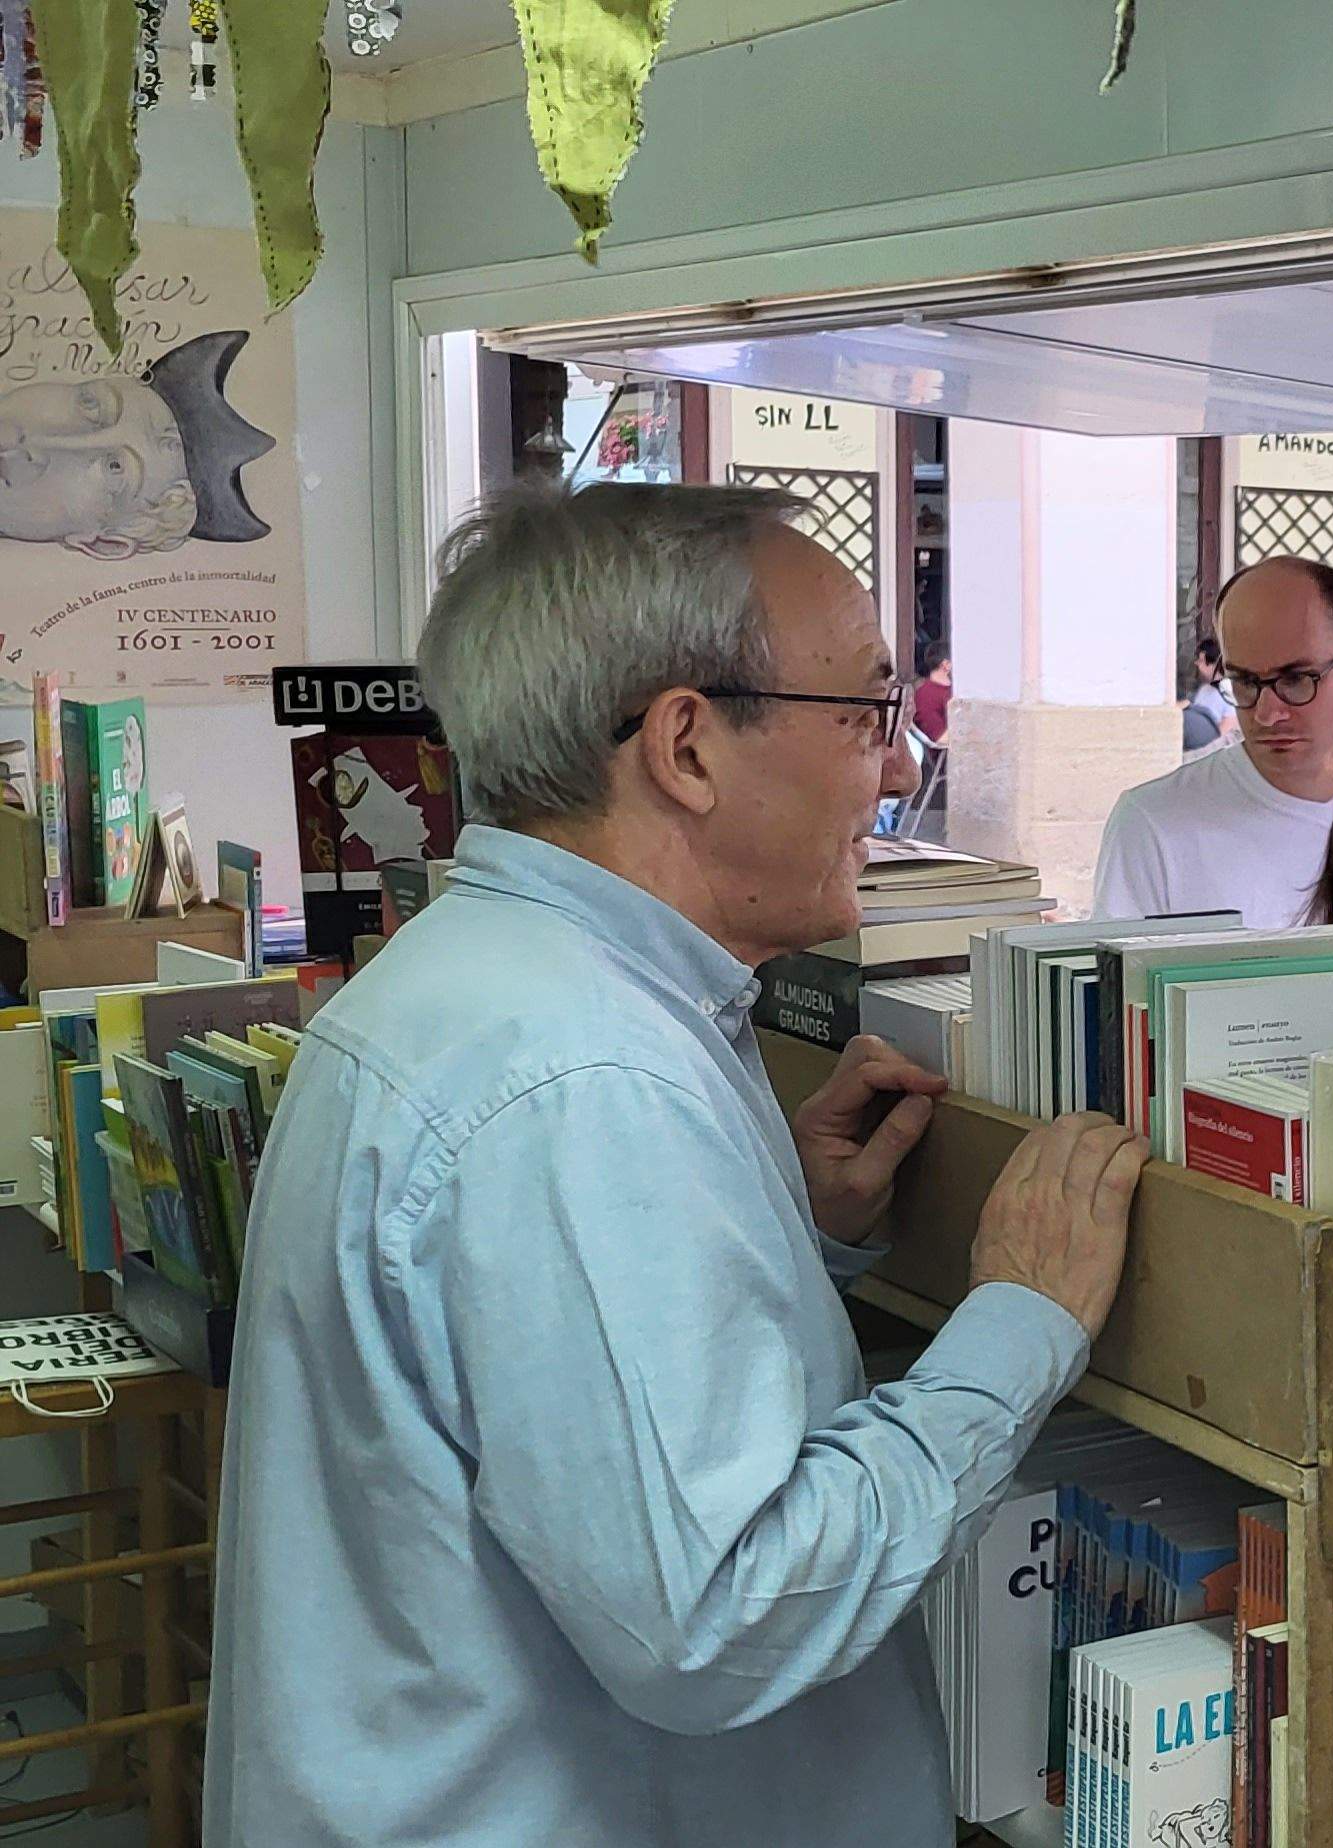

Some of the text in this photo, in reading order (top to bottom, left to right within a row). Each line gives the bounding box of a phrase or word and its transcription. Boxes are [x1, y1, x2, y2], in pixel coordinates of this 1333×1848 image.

[755, 403, 839, 430] SIN LL
[30, 570, 277, 639] Teatro de la fama, centro de la inmortalidad
[117, 609, 277, 624] IV CENTENARIO
[117, 628, 182, 651] 1601
[211, 634, 276, 651] 2001
[774, 979, 835, 1041] ALMUDENA GRANDES
[0, 1324, 139, 1349] LIBRO
[56, 1335, 148, 1355] DEL
[12, 1350, 156, 1371] FERIA
[1156, 1701, 1194, 1754] LA
